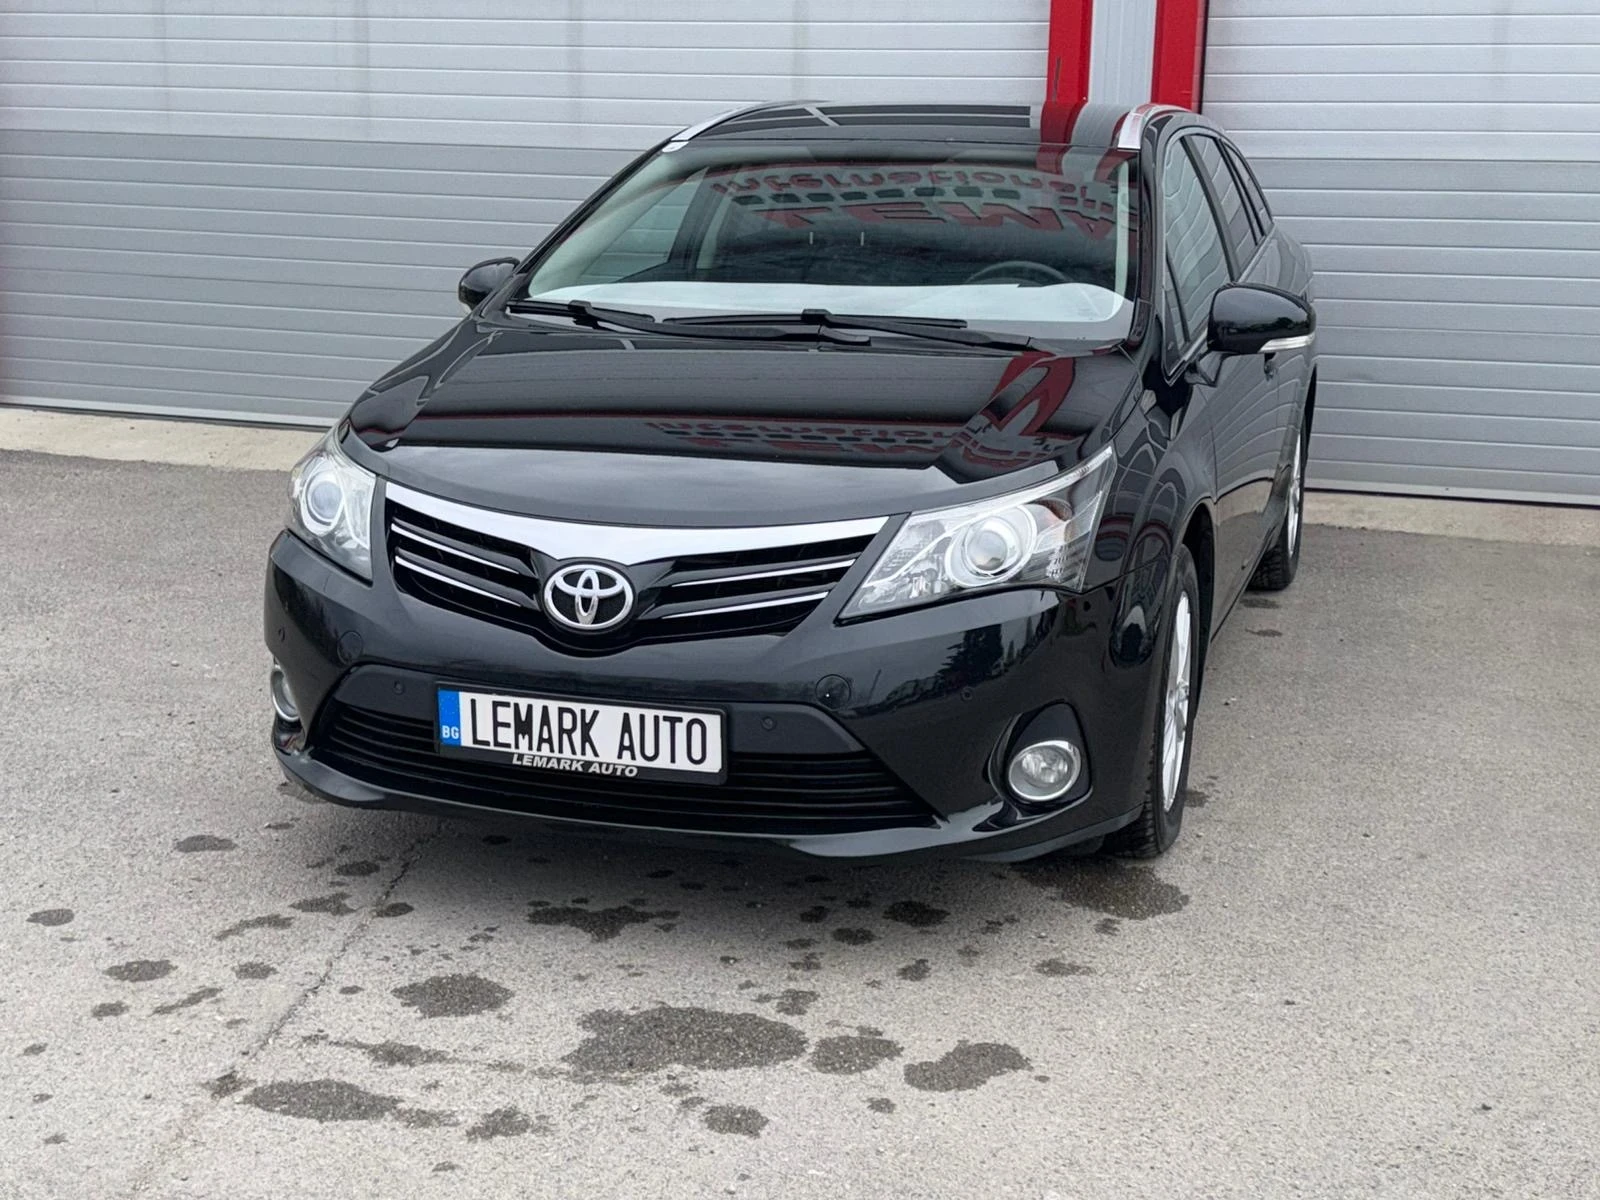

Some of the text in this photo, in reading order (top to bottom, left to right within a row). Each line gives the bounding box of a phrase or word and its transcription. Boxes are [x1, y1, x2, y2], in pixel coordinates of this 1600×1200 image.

[442, 725, 459, 740] BG
[470, 698, 707, 766] LEMARK AUTO
[512, 753, 638, 777] LEMARK AUTO
